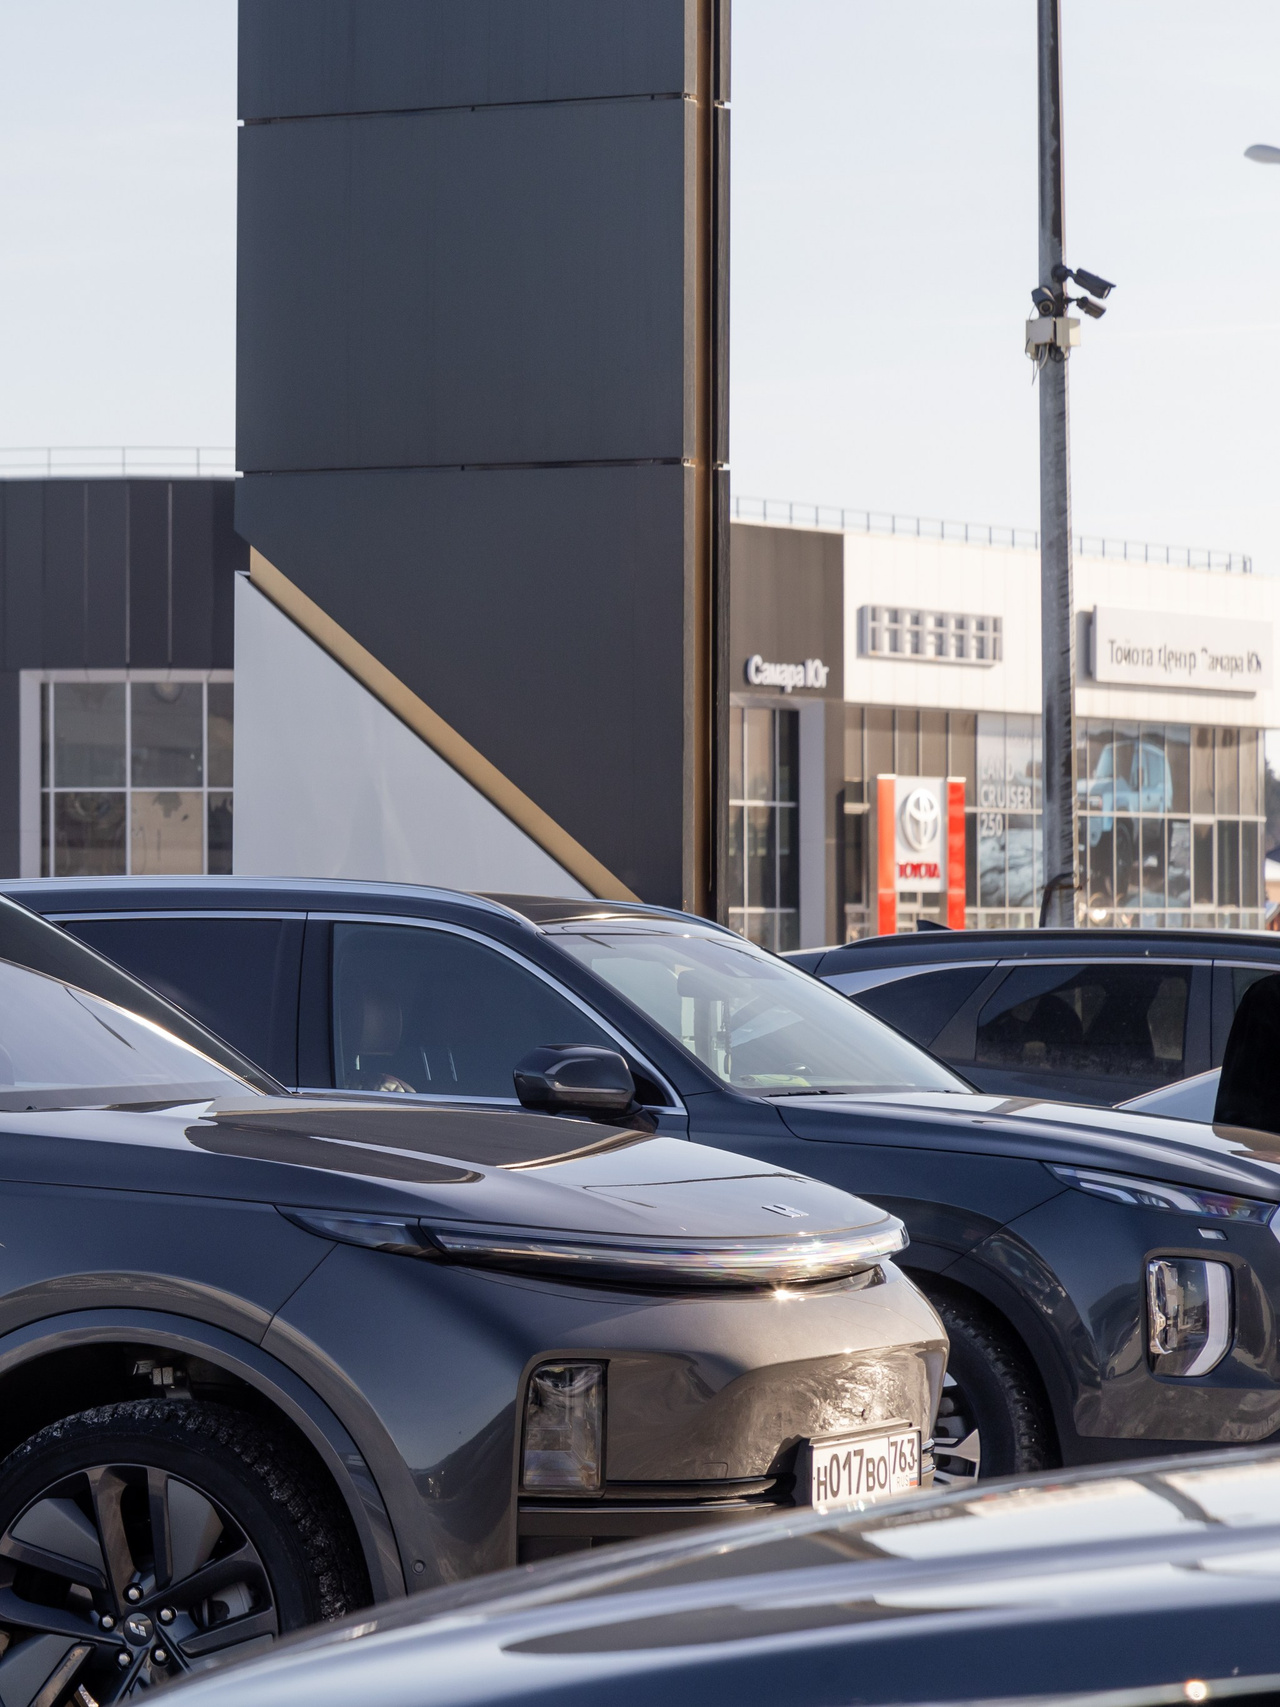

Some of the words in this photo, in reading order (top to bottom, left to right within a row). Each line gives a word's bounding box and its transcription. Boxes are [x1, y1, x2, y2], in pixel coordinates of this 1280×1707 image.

[1108, 638, 1153, 667] Тойота
[747, 654, 805, 693] Самара
[805, 658, 829, 688] Юг
[980, 783, 1032, 810] CRUISER
[981, 814, 1004, 837] 250
[898, 862, 941, 879] TOYOTA
[897, 1475, 909, 1487] RUS
